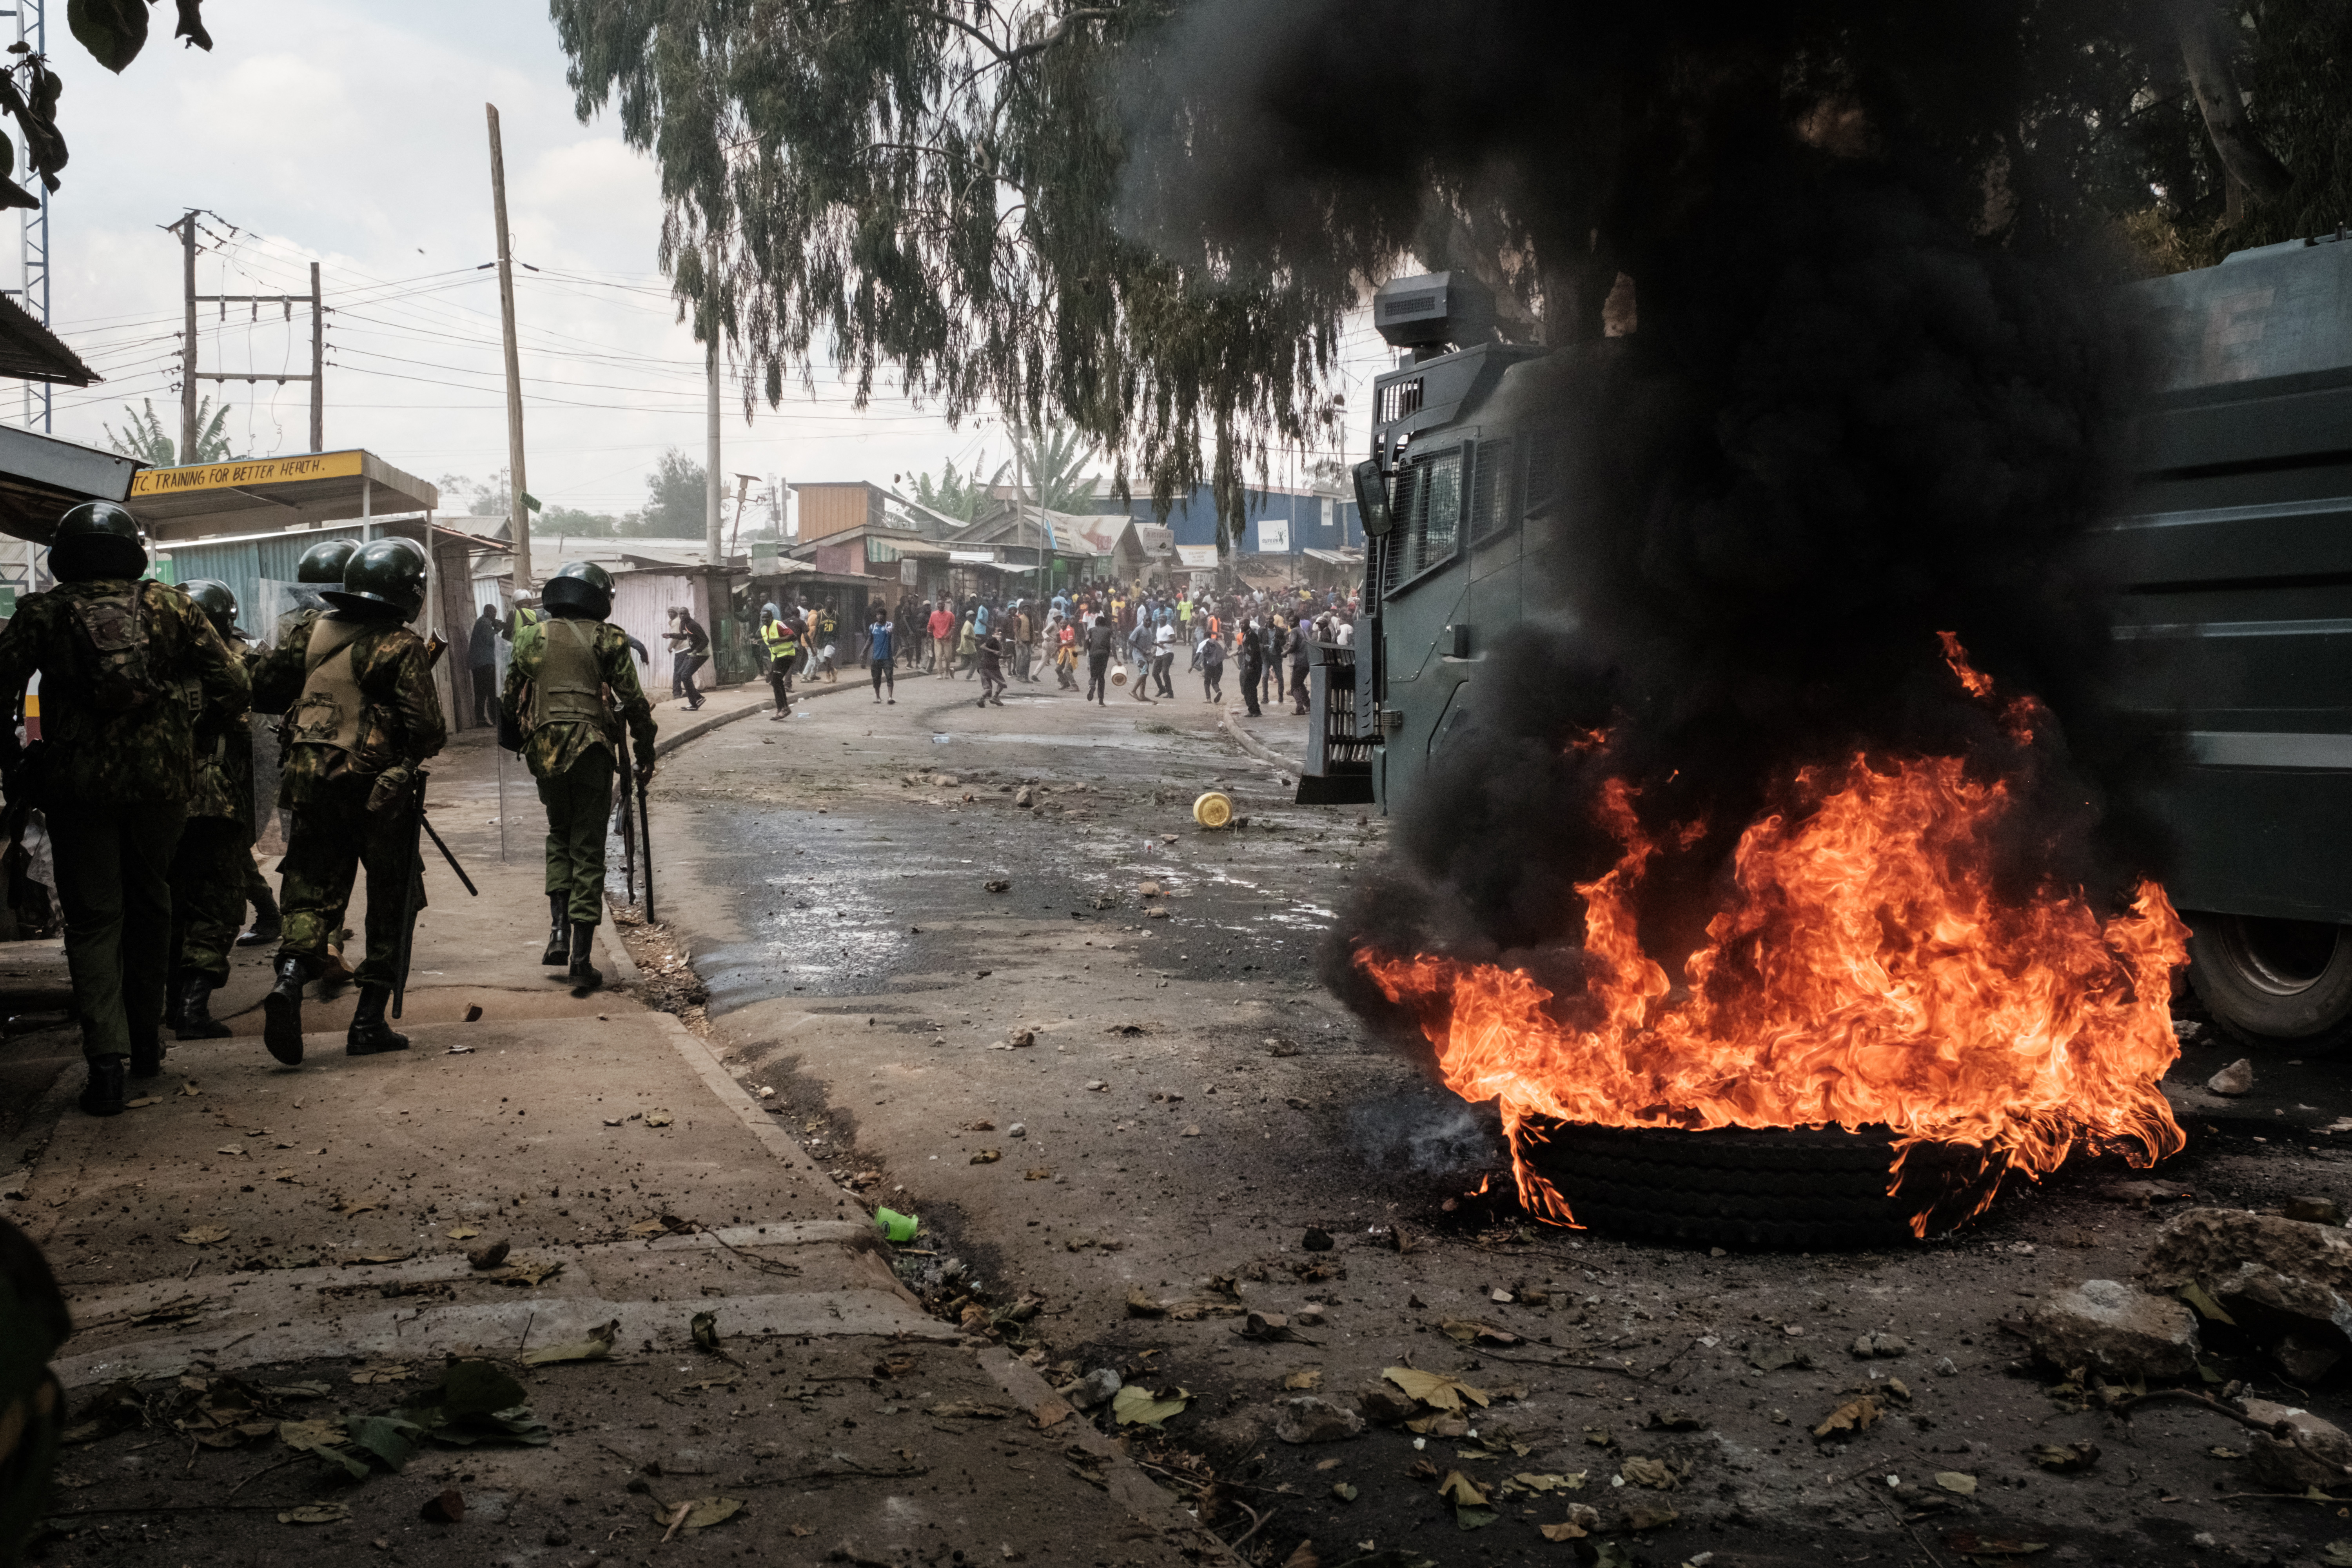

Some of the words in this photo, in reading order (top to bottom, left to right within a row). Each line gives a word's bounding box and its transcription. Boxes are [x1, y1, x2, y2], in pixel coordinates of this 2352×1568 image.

[156, 470, 205, 490] TRAINING
[209, 468, 229, 483] FOR
[233, 465, 274, 481] BETTER
[280, 459, 325, 476] HEALTH.
[824, 623, 833, 632] 20
